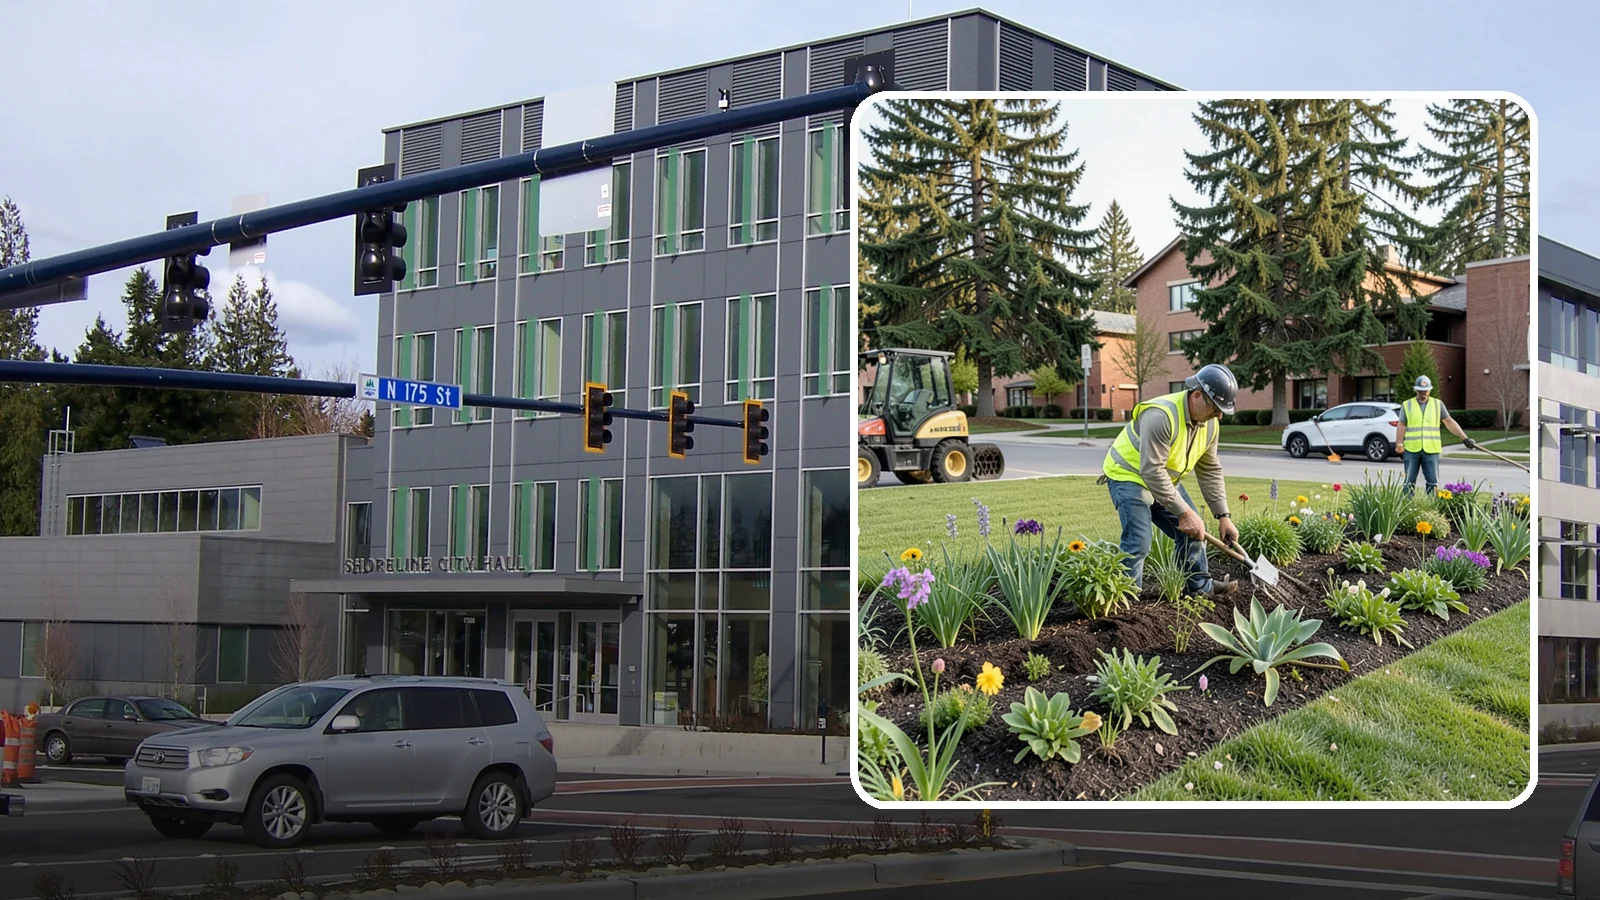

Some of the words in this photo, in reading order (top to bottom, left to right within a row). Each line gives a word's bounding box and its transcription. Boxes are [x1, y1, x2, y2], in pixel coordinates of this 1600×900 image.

[387, 380, 396, 399] N
[405, 382, 427, 403] 175
[436, 386, 451, 406] St
[344, 557, 433, 573] SHORELINE
[438, 555, 475, 572] CITY
[483, 555, 526, 571] HALL
